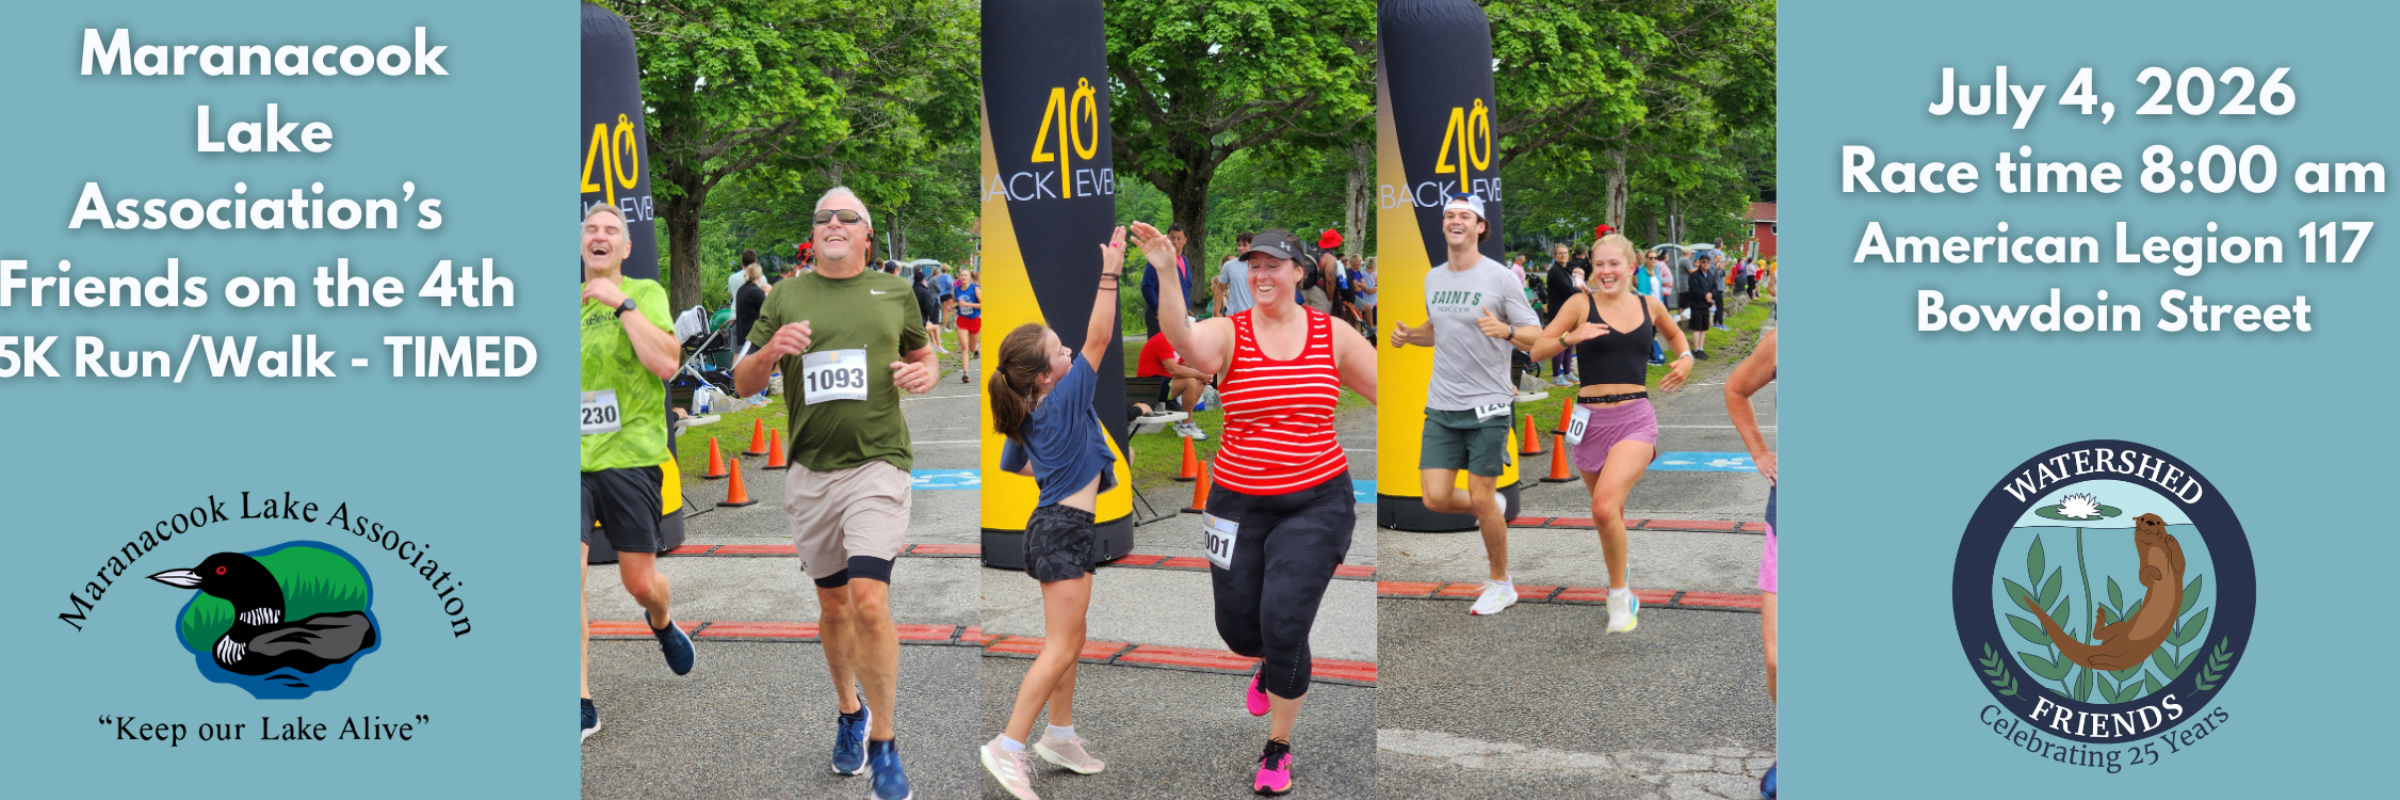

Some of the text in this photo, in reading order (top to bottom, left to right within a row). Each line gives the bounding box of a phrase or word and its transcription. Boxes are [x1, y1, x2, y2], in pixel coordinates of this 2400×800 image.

[1380, 180, 1456, 209] BACK
[1438, 305, 1471, 313] SOCCER
[807, 367, 865, 392] 1093
[582, 405, 617, 425] 230
[1205, 530, 1229, 558] 001
